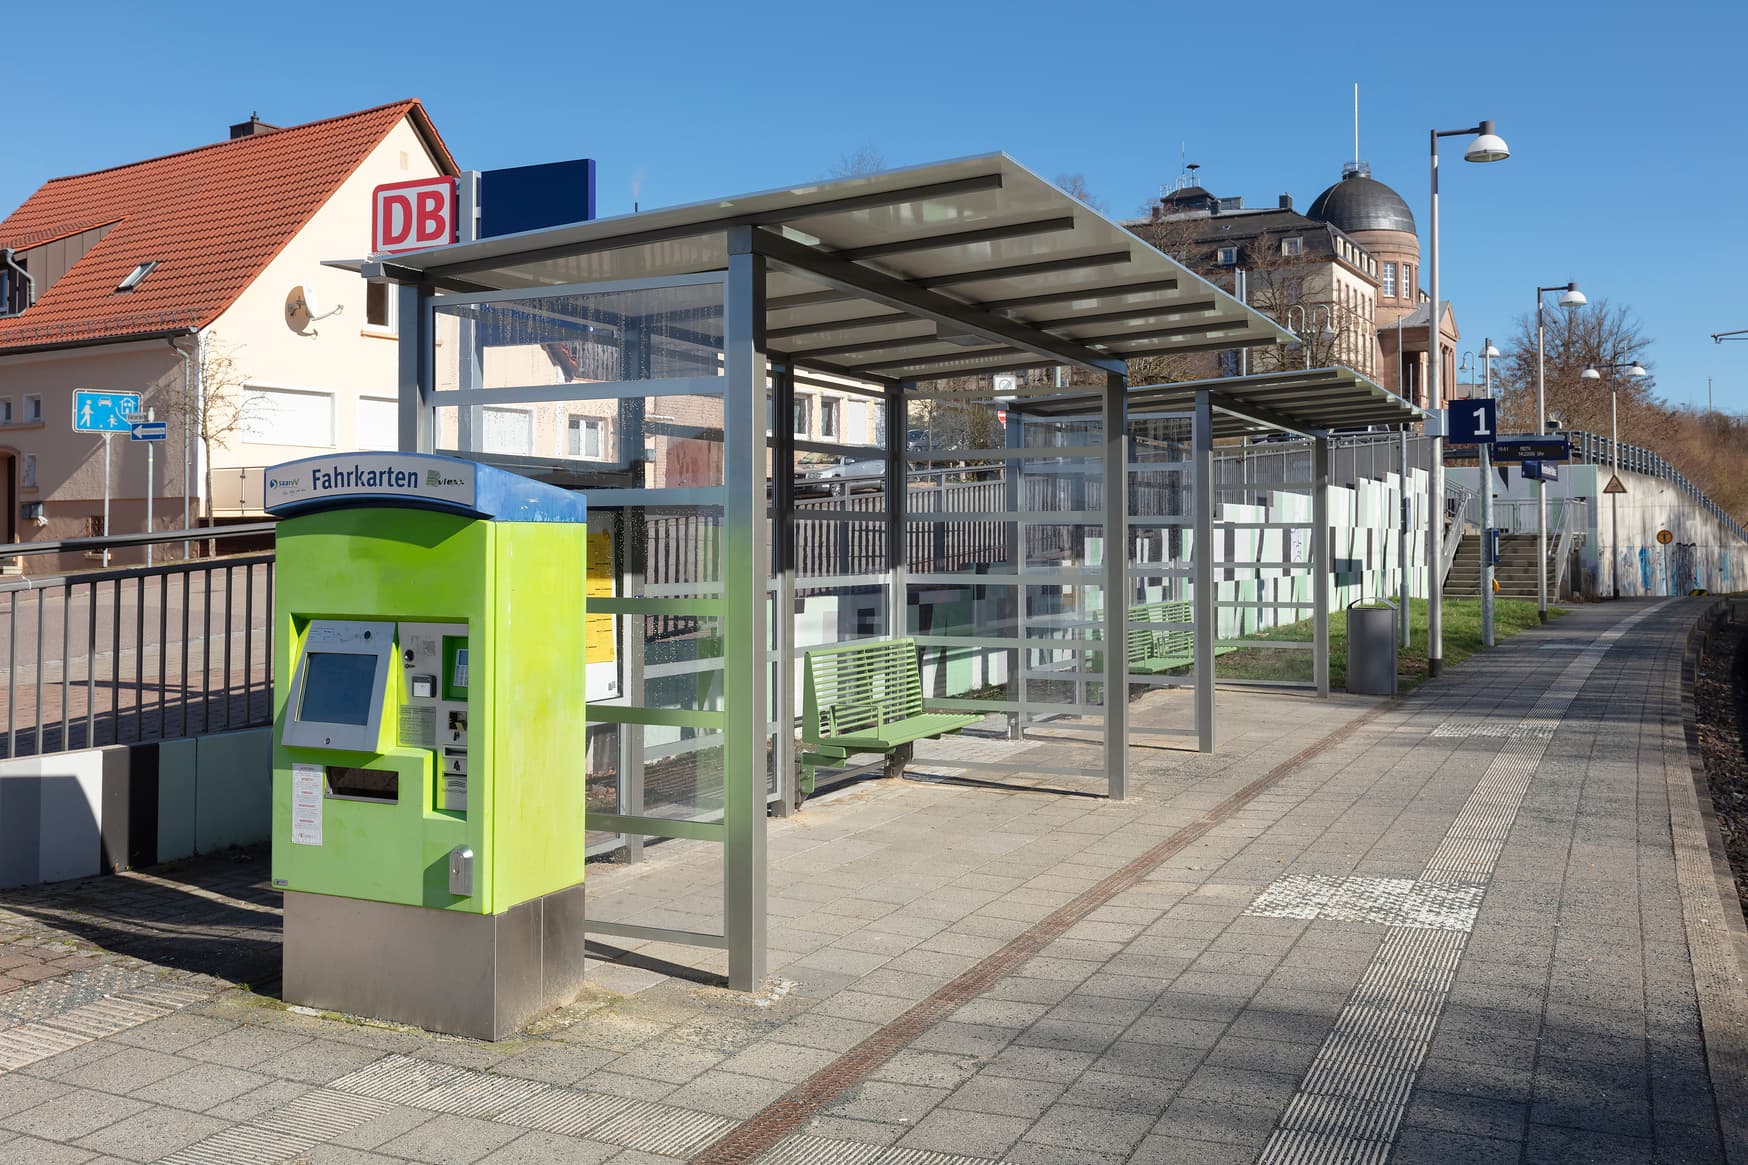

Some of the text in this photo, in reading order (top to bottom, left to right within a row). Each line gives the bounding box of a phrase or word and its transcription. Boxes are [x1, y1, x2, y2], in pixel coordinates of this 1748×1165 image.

[383, 190, 446, 246] DB
[1473, 407, 1490, 435] 1
[312, 463, 418, 490] Fahrkarten
